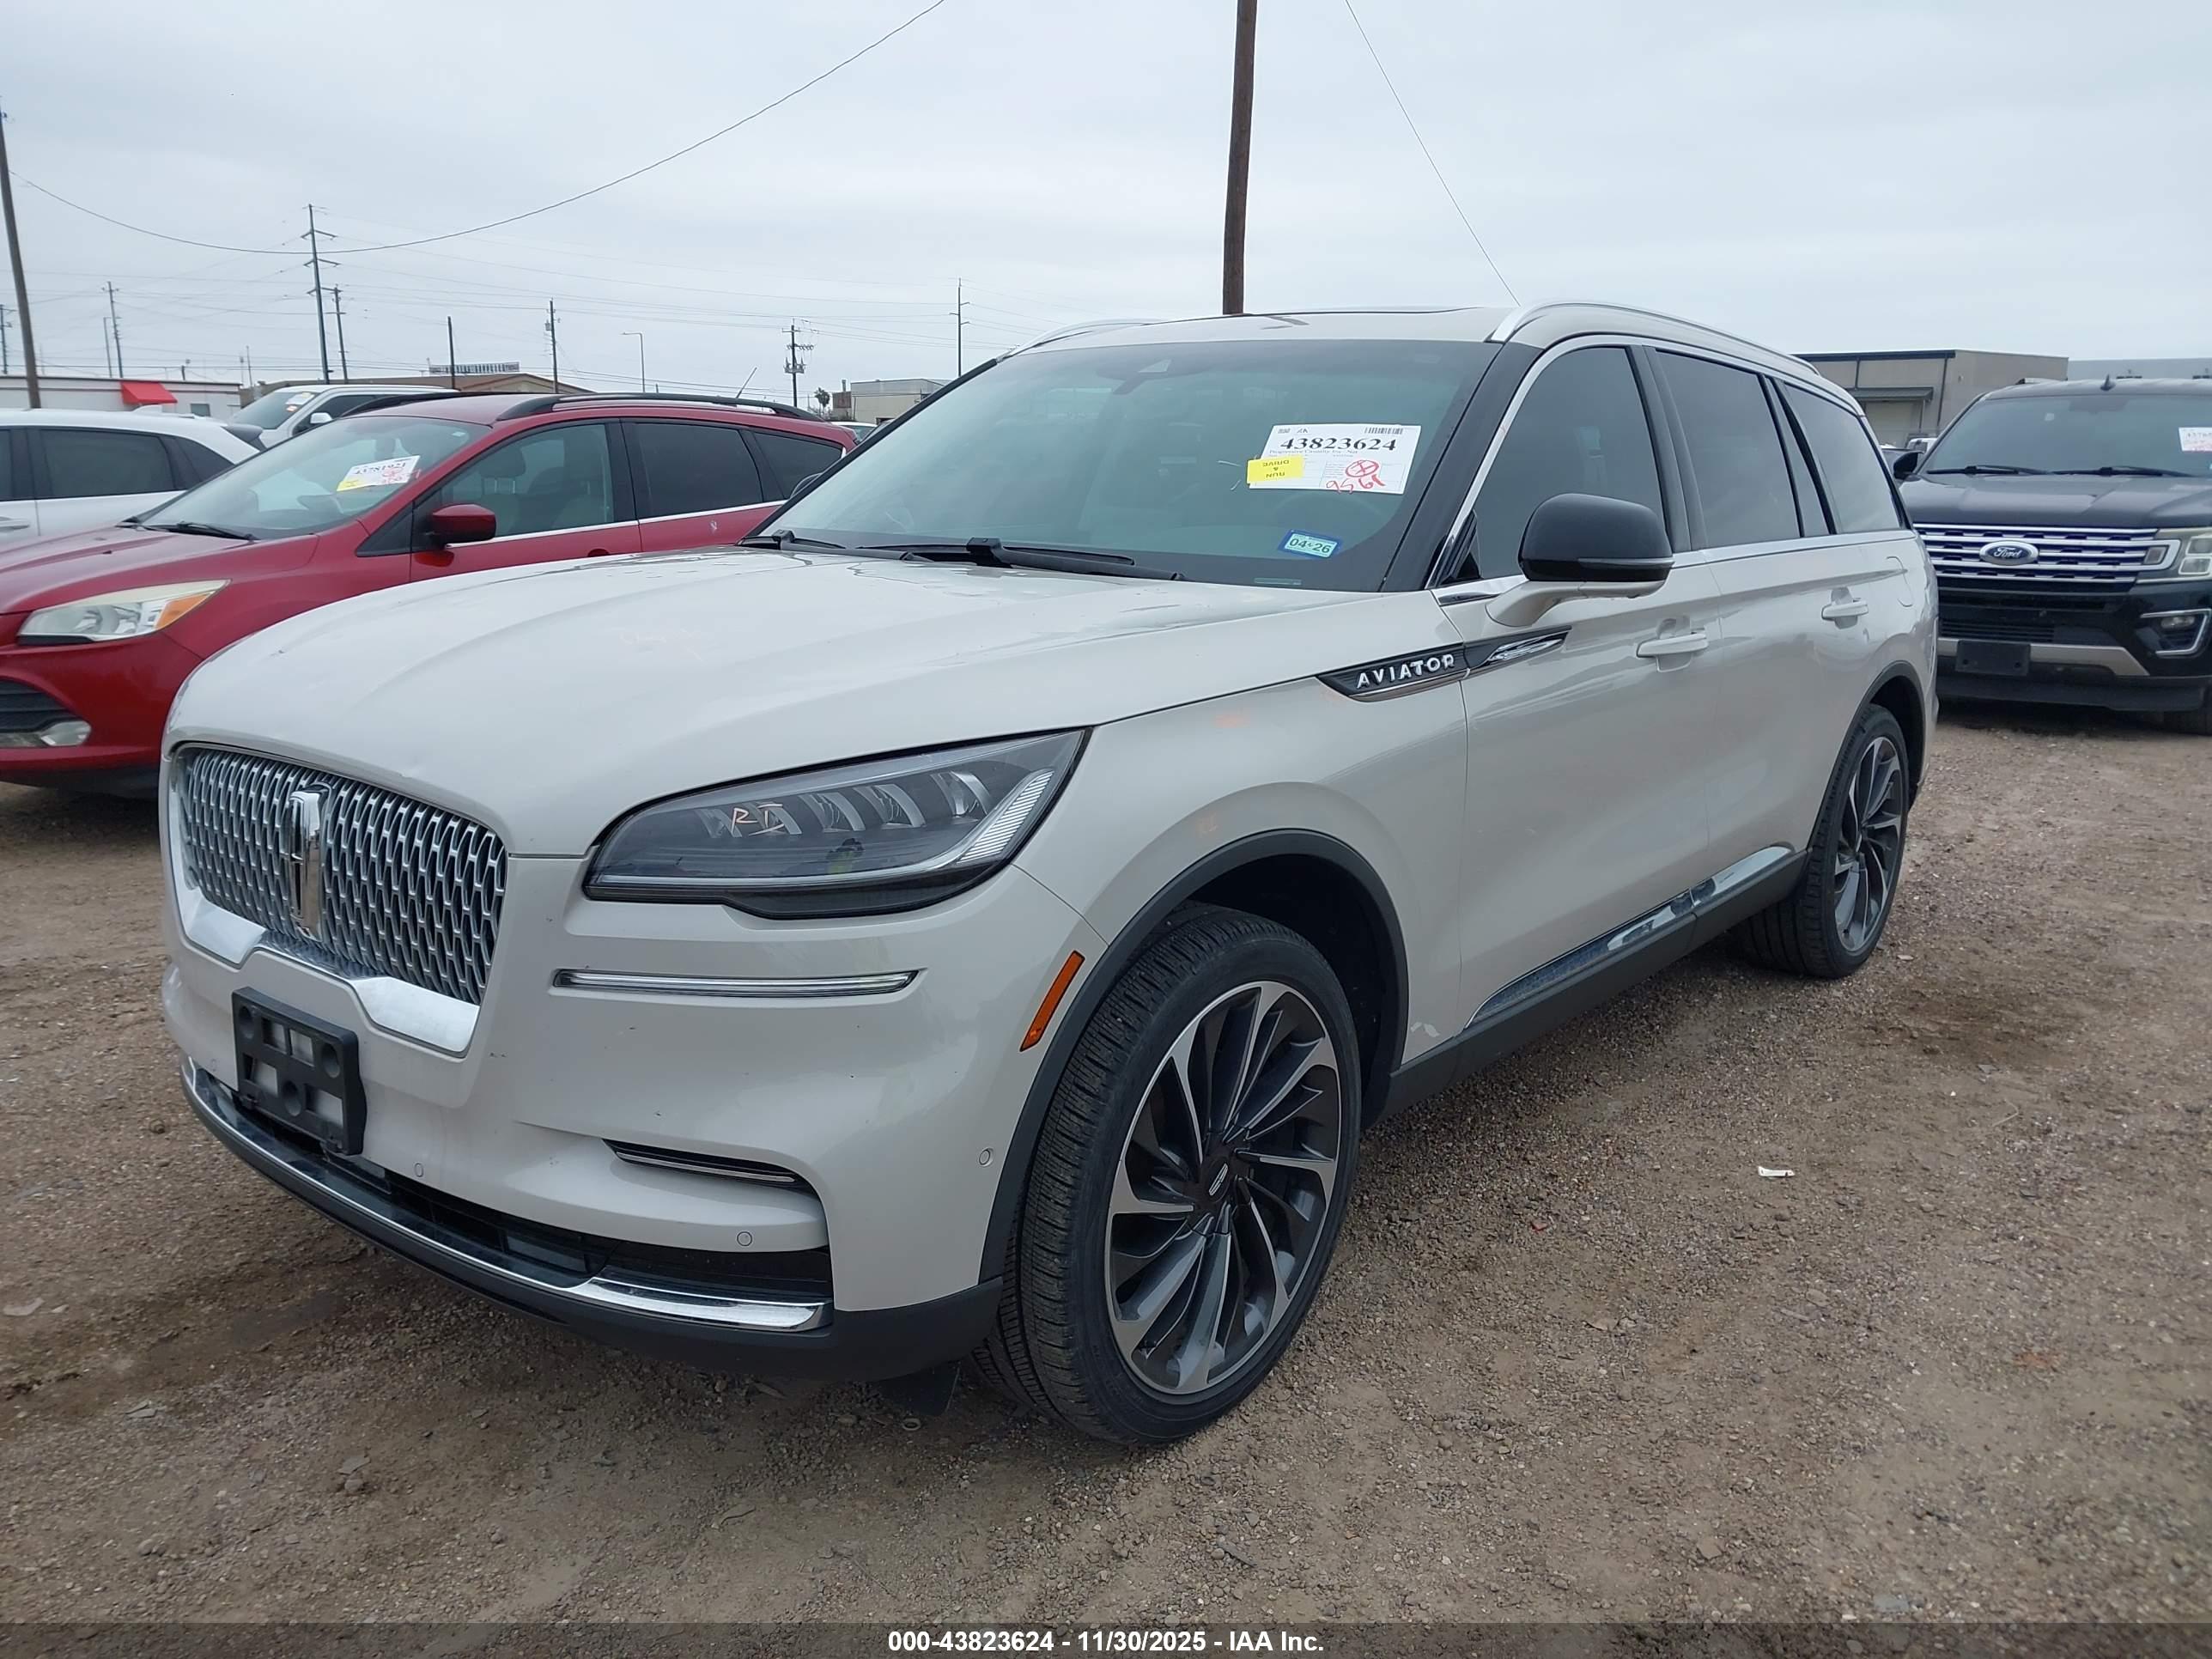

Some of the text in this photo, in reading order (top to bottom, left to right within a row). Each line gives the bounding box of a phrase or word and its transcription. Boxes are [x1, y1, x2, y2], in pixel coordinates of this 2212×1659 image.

[1279, 437, 1397, 451] 43823624
[1993, 546, 2023, 558] Ford
[1356, 653, 1455, 688] AVIATOR
